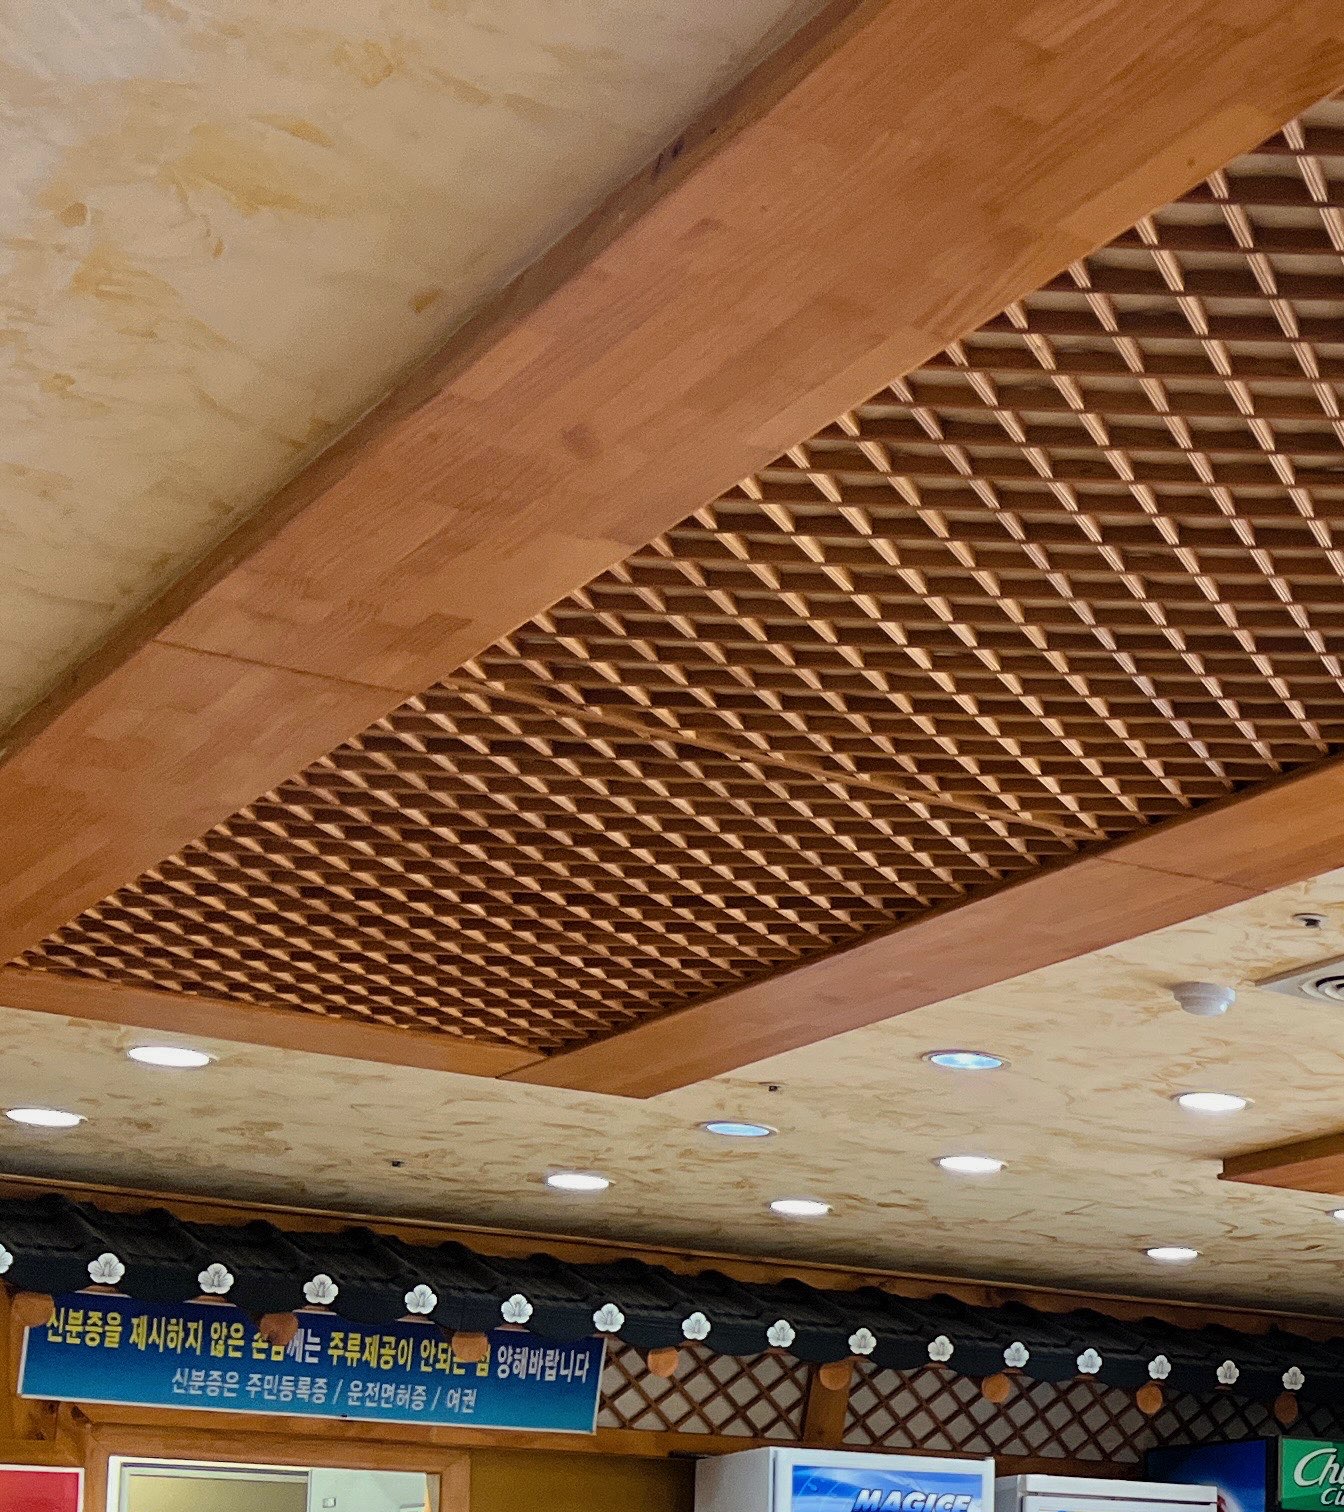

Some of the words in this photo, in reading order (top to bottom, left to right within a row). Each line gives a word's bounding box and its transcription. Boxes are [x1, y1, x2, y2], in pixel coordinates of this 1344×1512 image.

[46, 1307, 123, 1348] 신분증을
[129, 1315, 203, 1355] 제시하지
[210, 1322, 245, 1358] 않은
[327, 1331, 413, 1371] 주류제공이
[497, 1345, 590, 1383] 양해바랍니다
[171, 1367, 240, 1397] 신분증은
[245, 1373, 328, 1404] 주민등록증
[347, 1380, 428, 1411] 운전면허증
[445, 1387, 478, 1413] 여권
